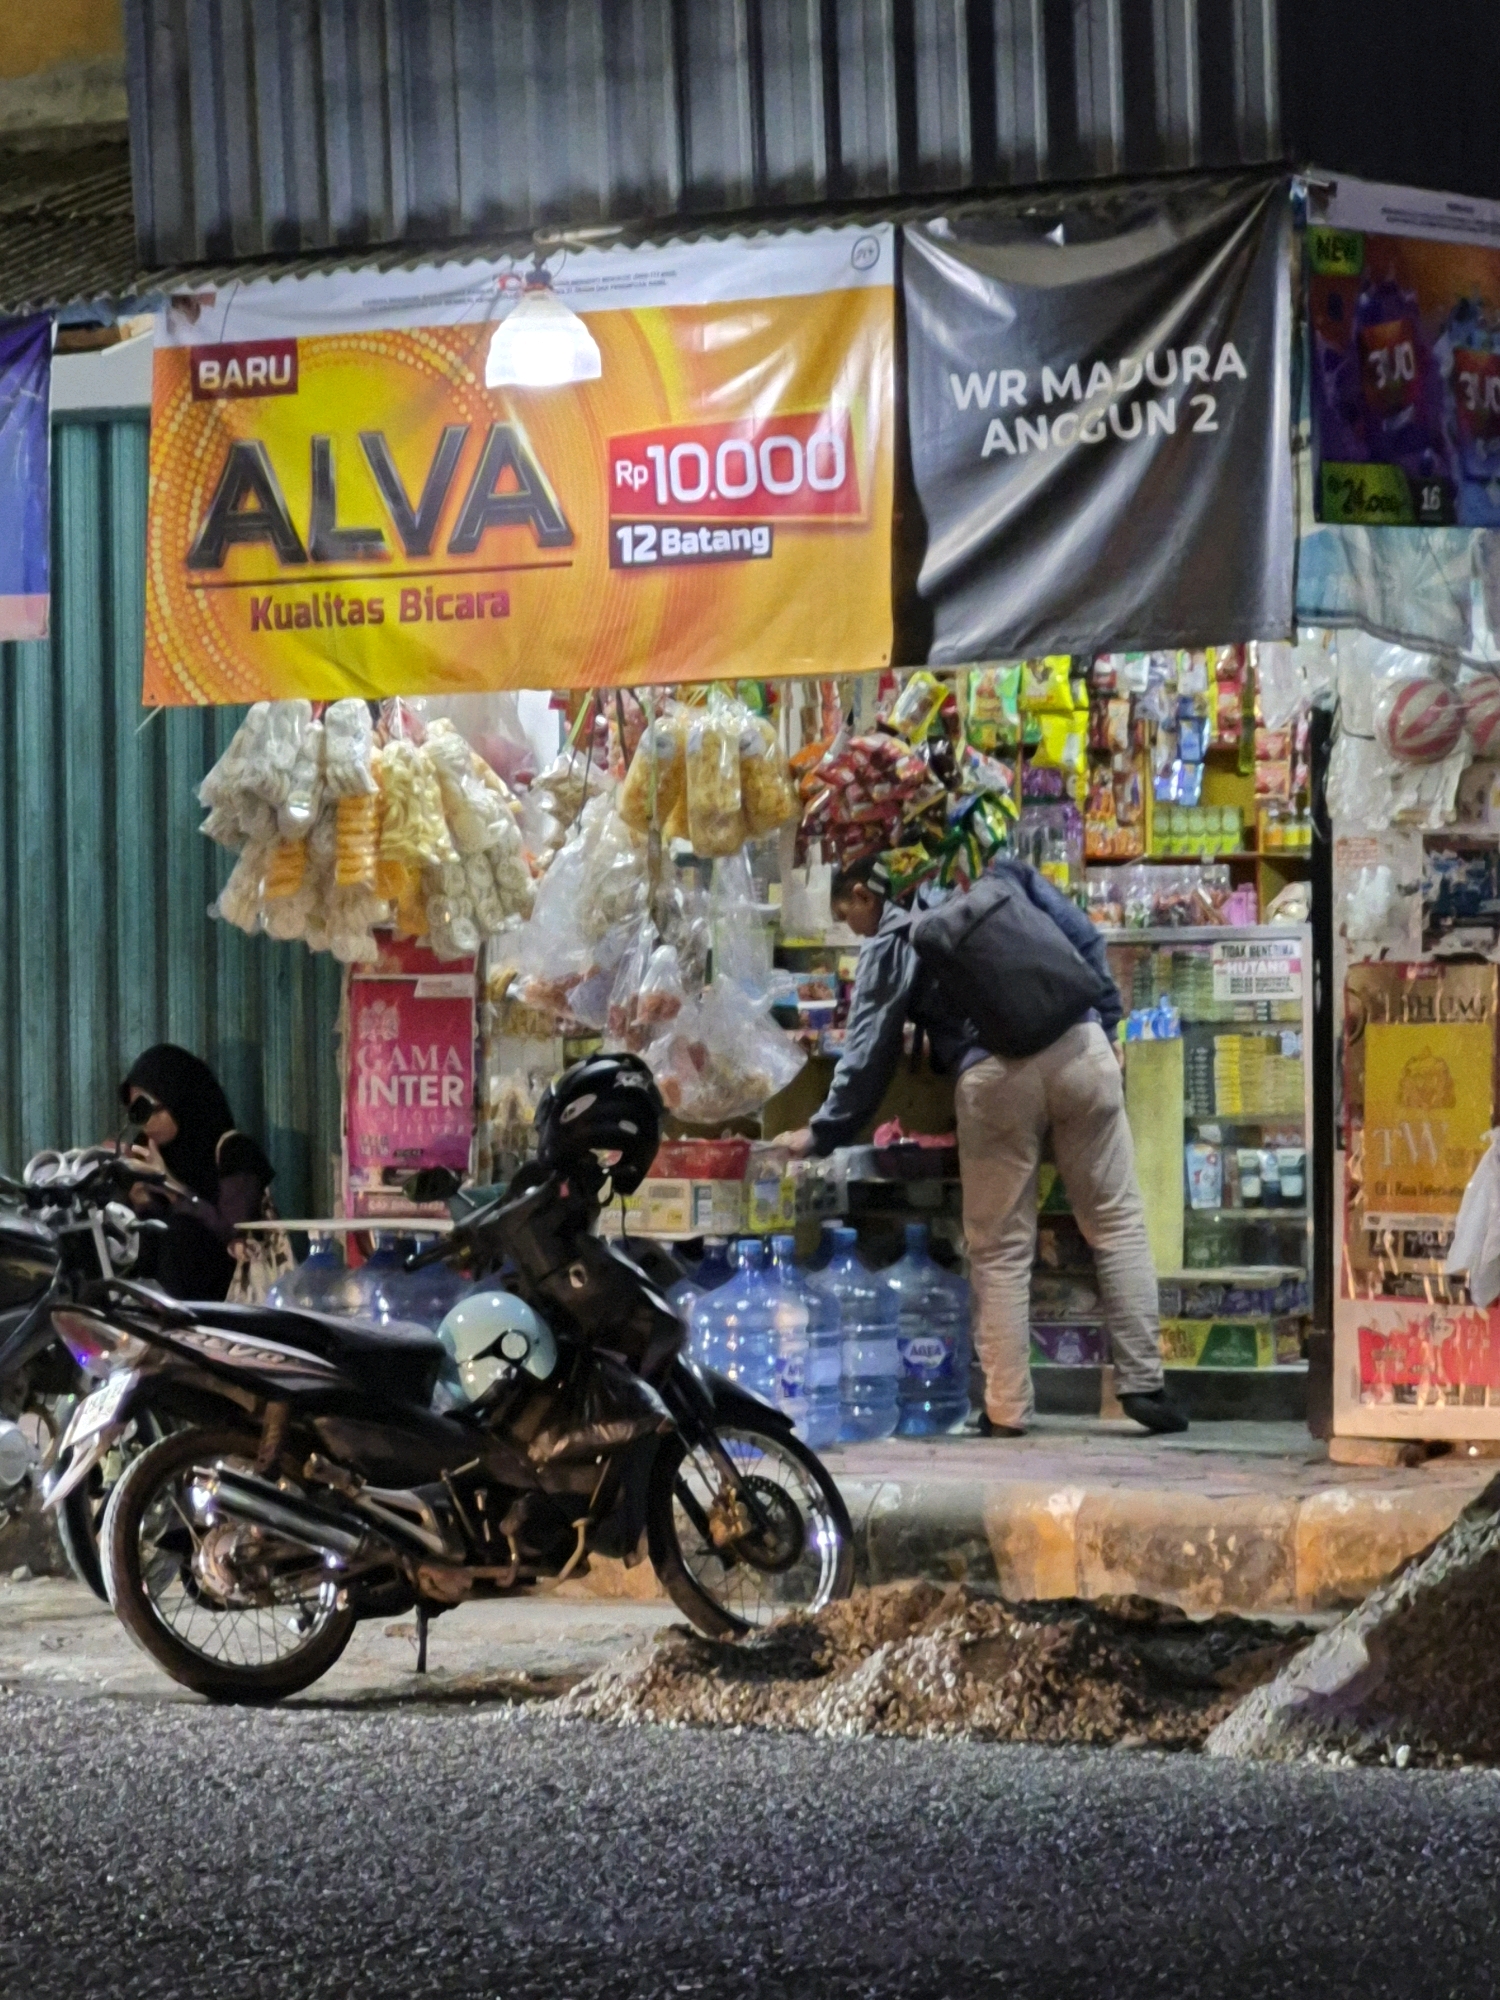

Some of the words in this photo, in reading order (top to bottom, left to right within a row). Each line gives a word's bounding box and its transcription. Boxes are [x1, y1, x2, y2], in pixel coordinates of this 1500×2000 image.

[1316, 233, 1358, 262] NEW
[199, 354, 291, 390] BARU
[950, 369, 1027, 411] WR
[1041, 342, 1247, 404] MADURA
[1189, 394, 1219, 433] 2
[186, 422, 573, 570] ALVA
[1421, 484, 1441, 511] 16
[616, 524, 658, 564] 12
[661, 526, 770, 557] Batang
[251, 592, 384, 631] Kualitas
[400, 586, 511, 623] Bicara
[357, 1044, 464, 1073] GAMA
[358, 1074, 465, 1108] INTER
